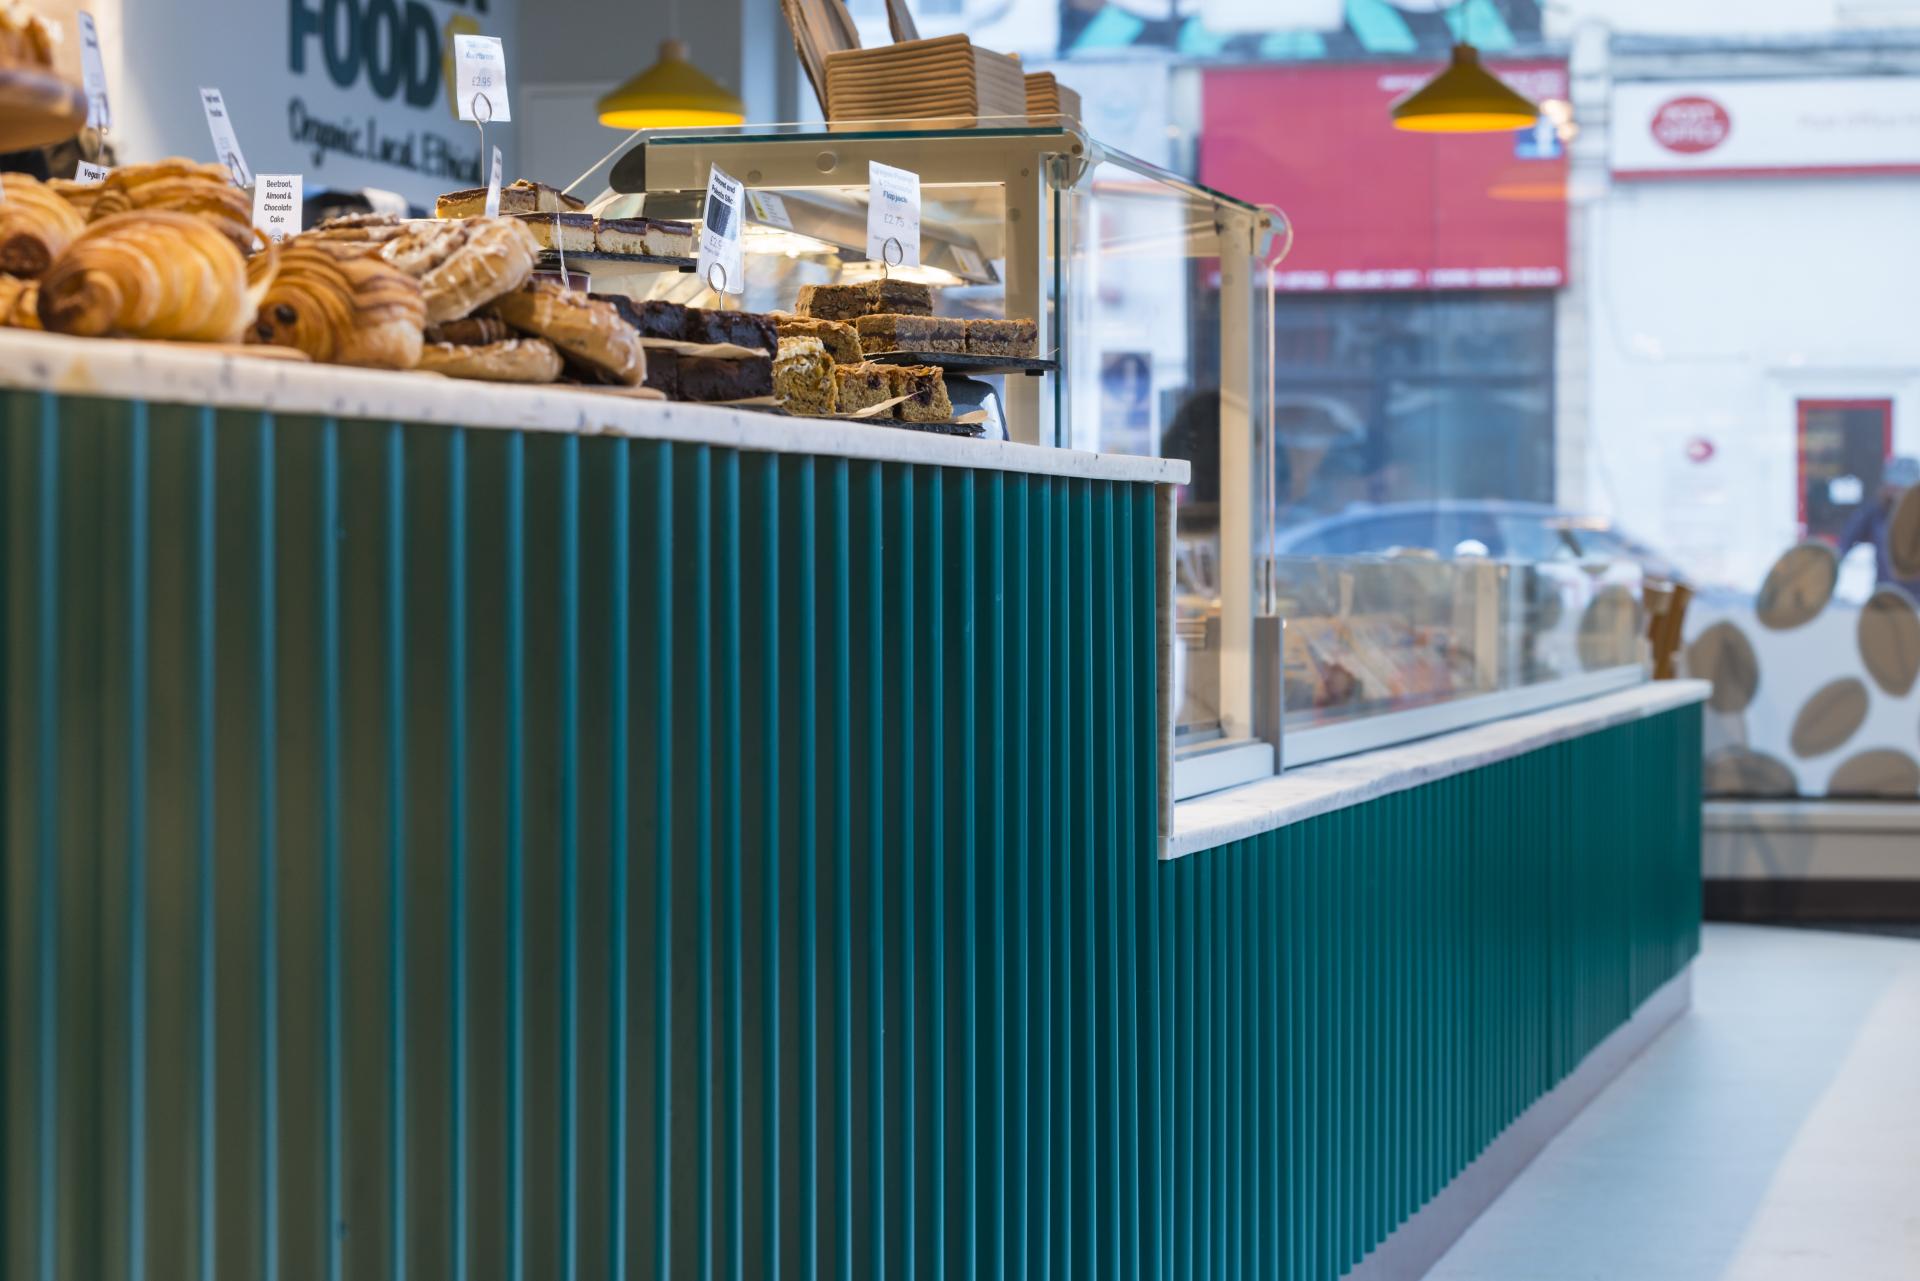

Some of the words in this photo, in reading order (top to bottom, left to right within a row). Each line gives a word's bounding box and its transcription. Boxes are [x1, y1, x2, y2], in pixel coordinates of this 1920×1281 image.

[288, 0, 441, 110] FOOD
[84, 168, 101, 180] Vegan
[266, 179, 293, 189] Beetroot,
[265, 191, 287, 200] Almond
[287, 191, 292, 200] &
[263, 203, 293, 211] Chocolate
[269, 215, 285, 223] Cake
